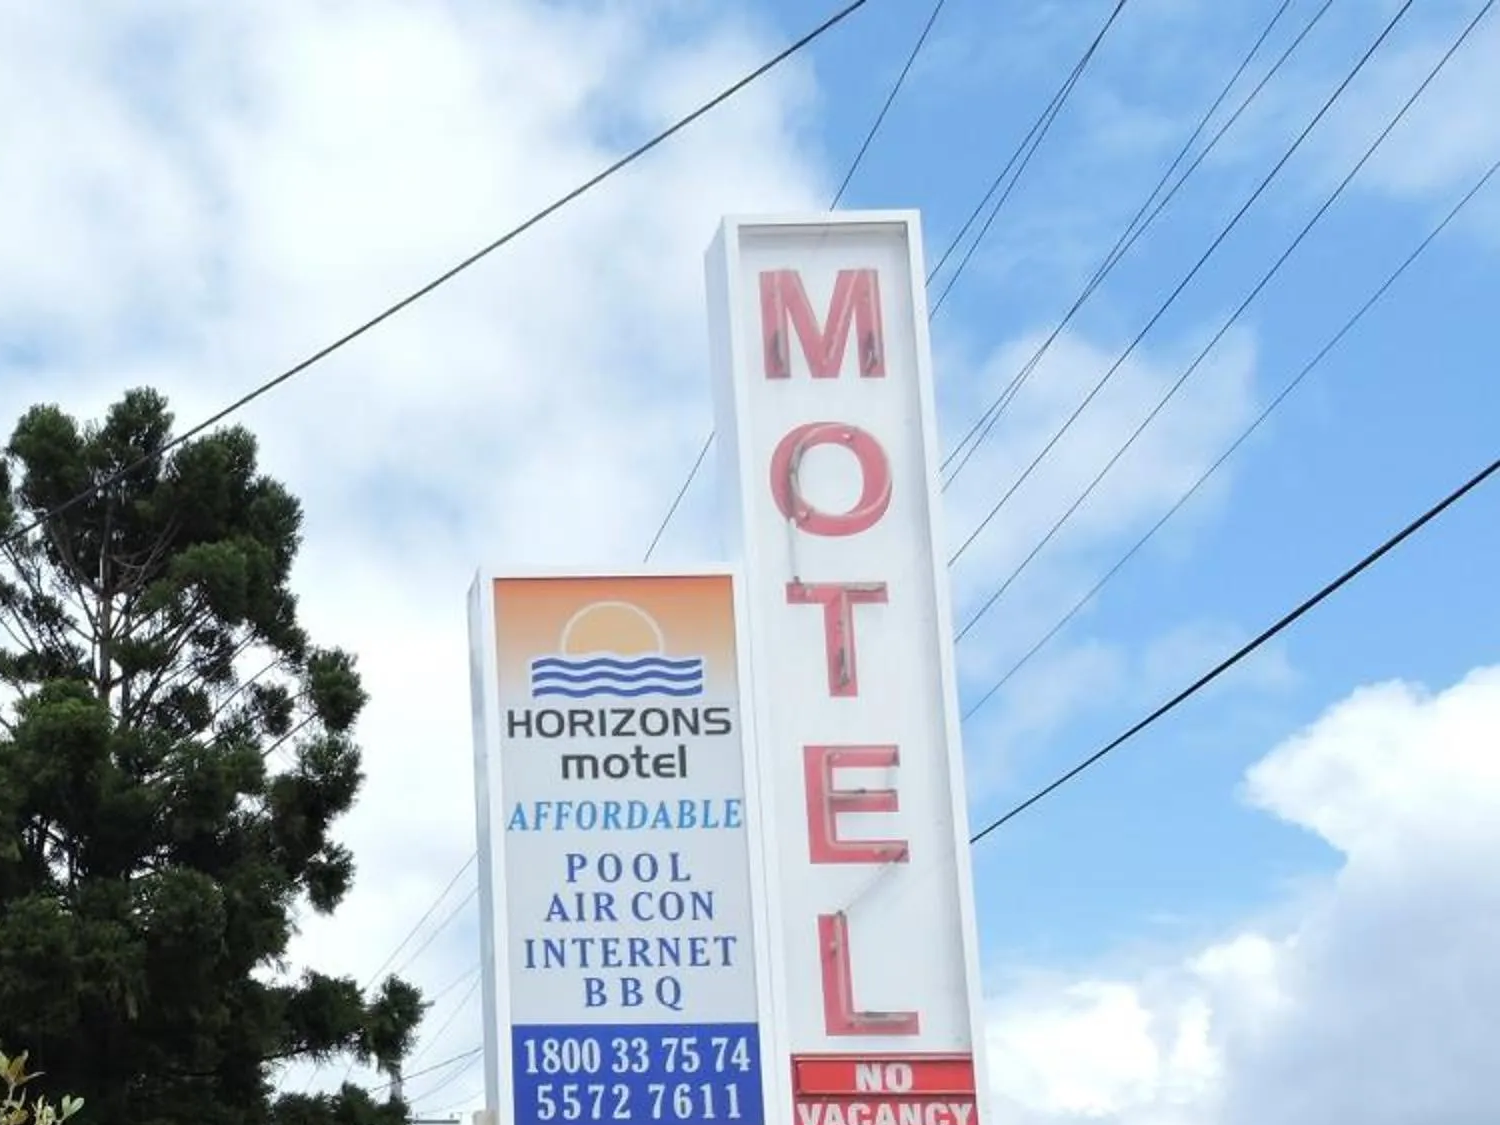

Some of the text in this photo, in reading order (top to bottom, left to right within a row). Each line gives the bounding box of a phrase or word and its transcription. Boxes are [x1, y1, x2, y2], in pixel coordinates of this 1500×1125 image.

[759, 269, 919, 1036] MOTEL
[507, 706, 732, 739] HORIZONS
[561, 744, 688, 780] motel
[507, 798, 742, 833] AFFORDABLE
[565, 853, 691, 883] POOL
[544, 890, 714, 922] AIR CON
[524, 935, 737, 970] INTERNET
[584, 976, 682, 1011] BBQ
[524, 1036, 751, 1074] 1800 33 75 74
[855, 1063, 913, 1092] NO
[536, 1082, 742, 1121] 5572 7611
